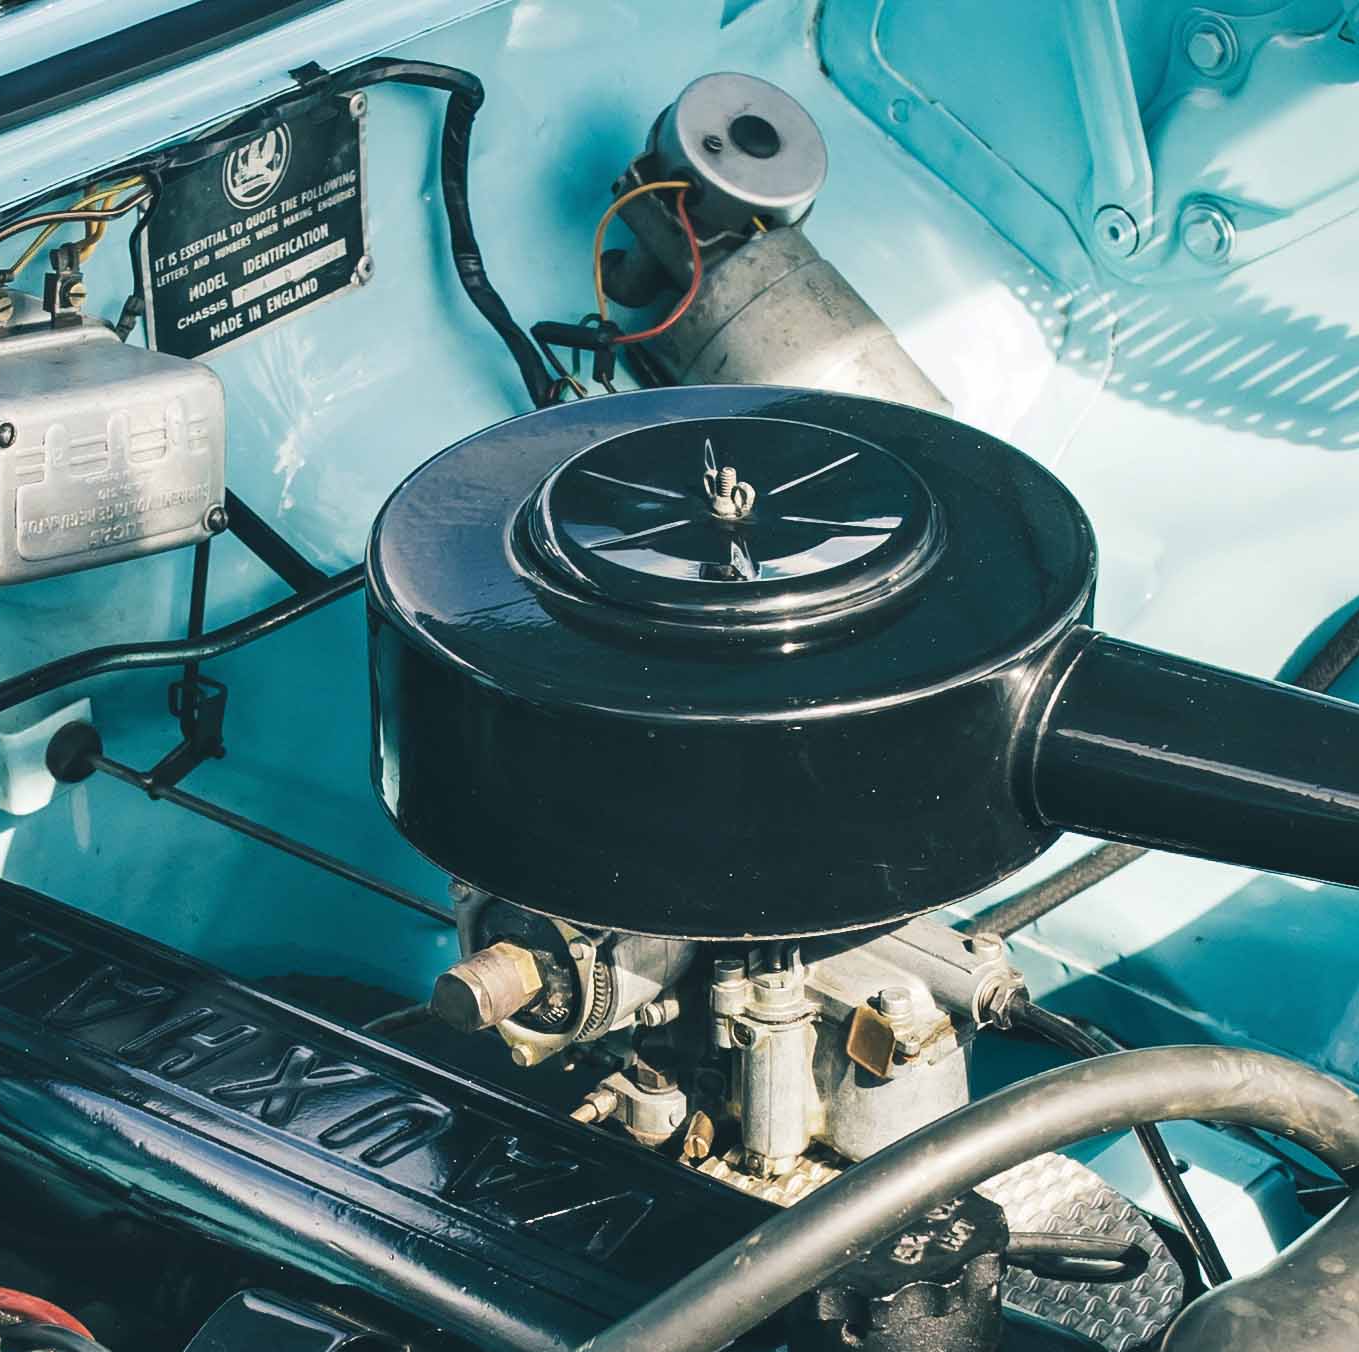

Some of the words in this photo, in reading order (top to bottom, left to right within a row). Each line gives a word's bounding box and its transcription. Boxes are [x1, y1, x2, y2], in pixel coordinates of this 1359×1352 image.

[155, 256, 166, 272] IT
[168, 253, 177, 266] IS
[180, 232, 228, 261] ESSENTIAL
[230, 222, 243, 236] TO
[246, 207, 277, 229] QUOTE
[281, 198, 298, 215] THE
[301, 170, 356, 208] FOLLOWING
[157, 267, 189, 287] LETTERS
[193, 255, 210, 270] AND
[214, 234, 251, 260] NUMBERS
[255, 223, 279, 241] WHEN
[283, 207, 313, 228] MAKING
[189, 272, 228, 302] MODEL
[243, 224, 329, 276] IDENTIFICATION
[177, 299, 228, 330] CHASSIS
[210, 314, 243, 341] MADE
[248, 305, 262, 323] IN
[267, 278, 319, 314] ENGLAND
